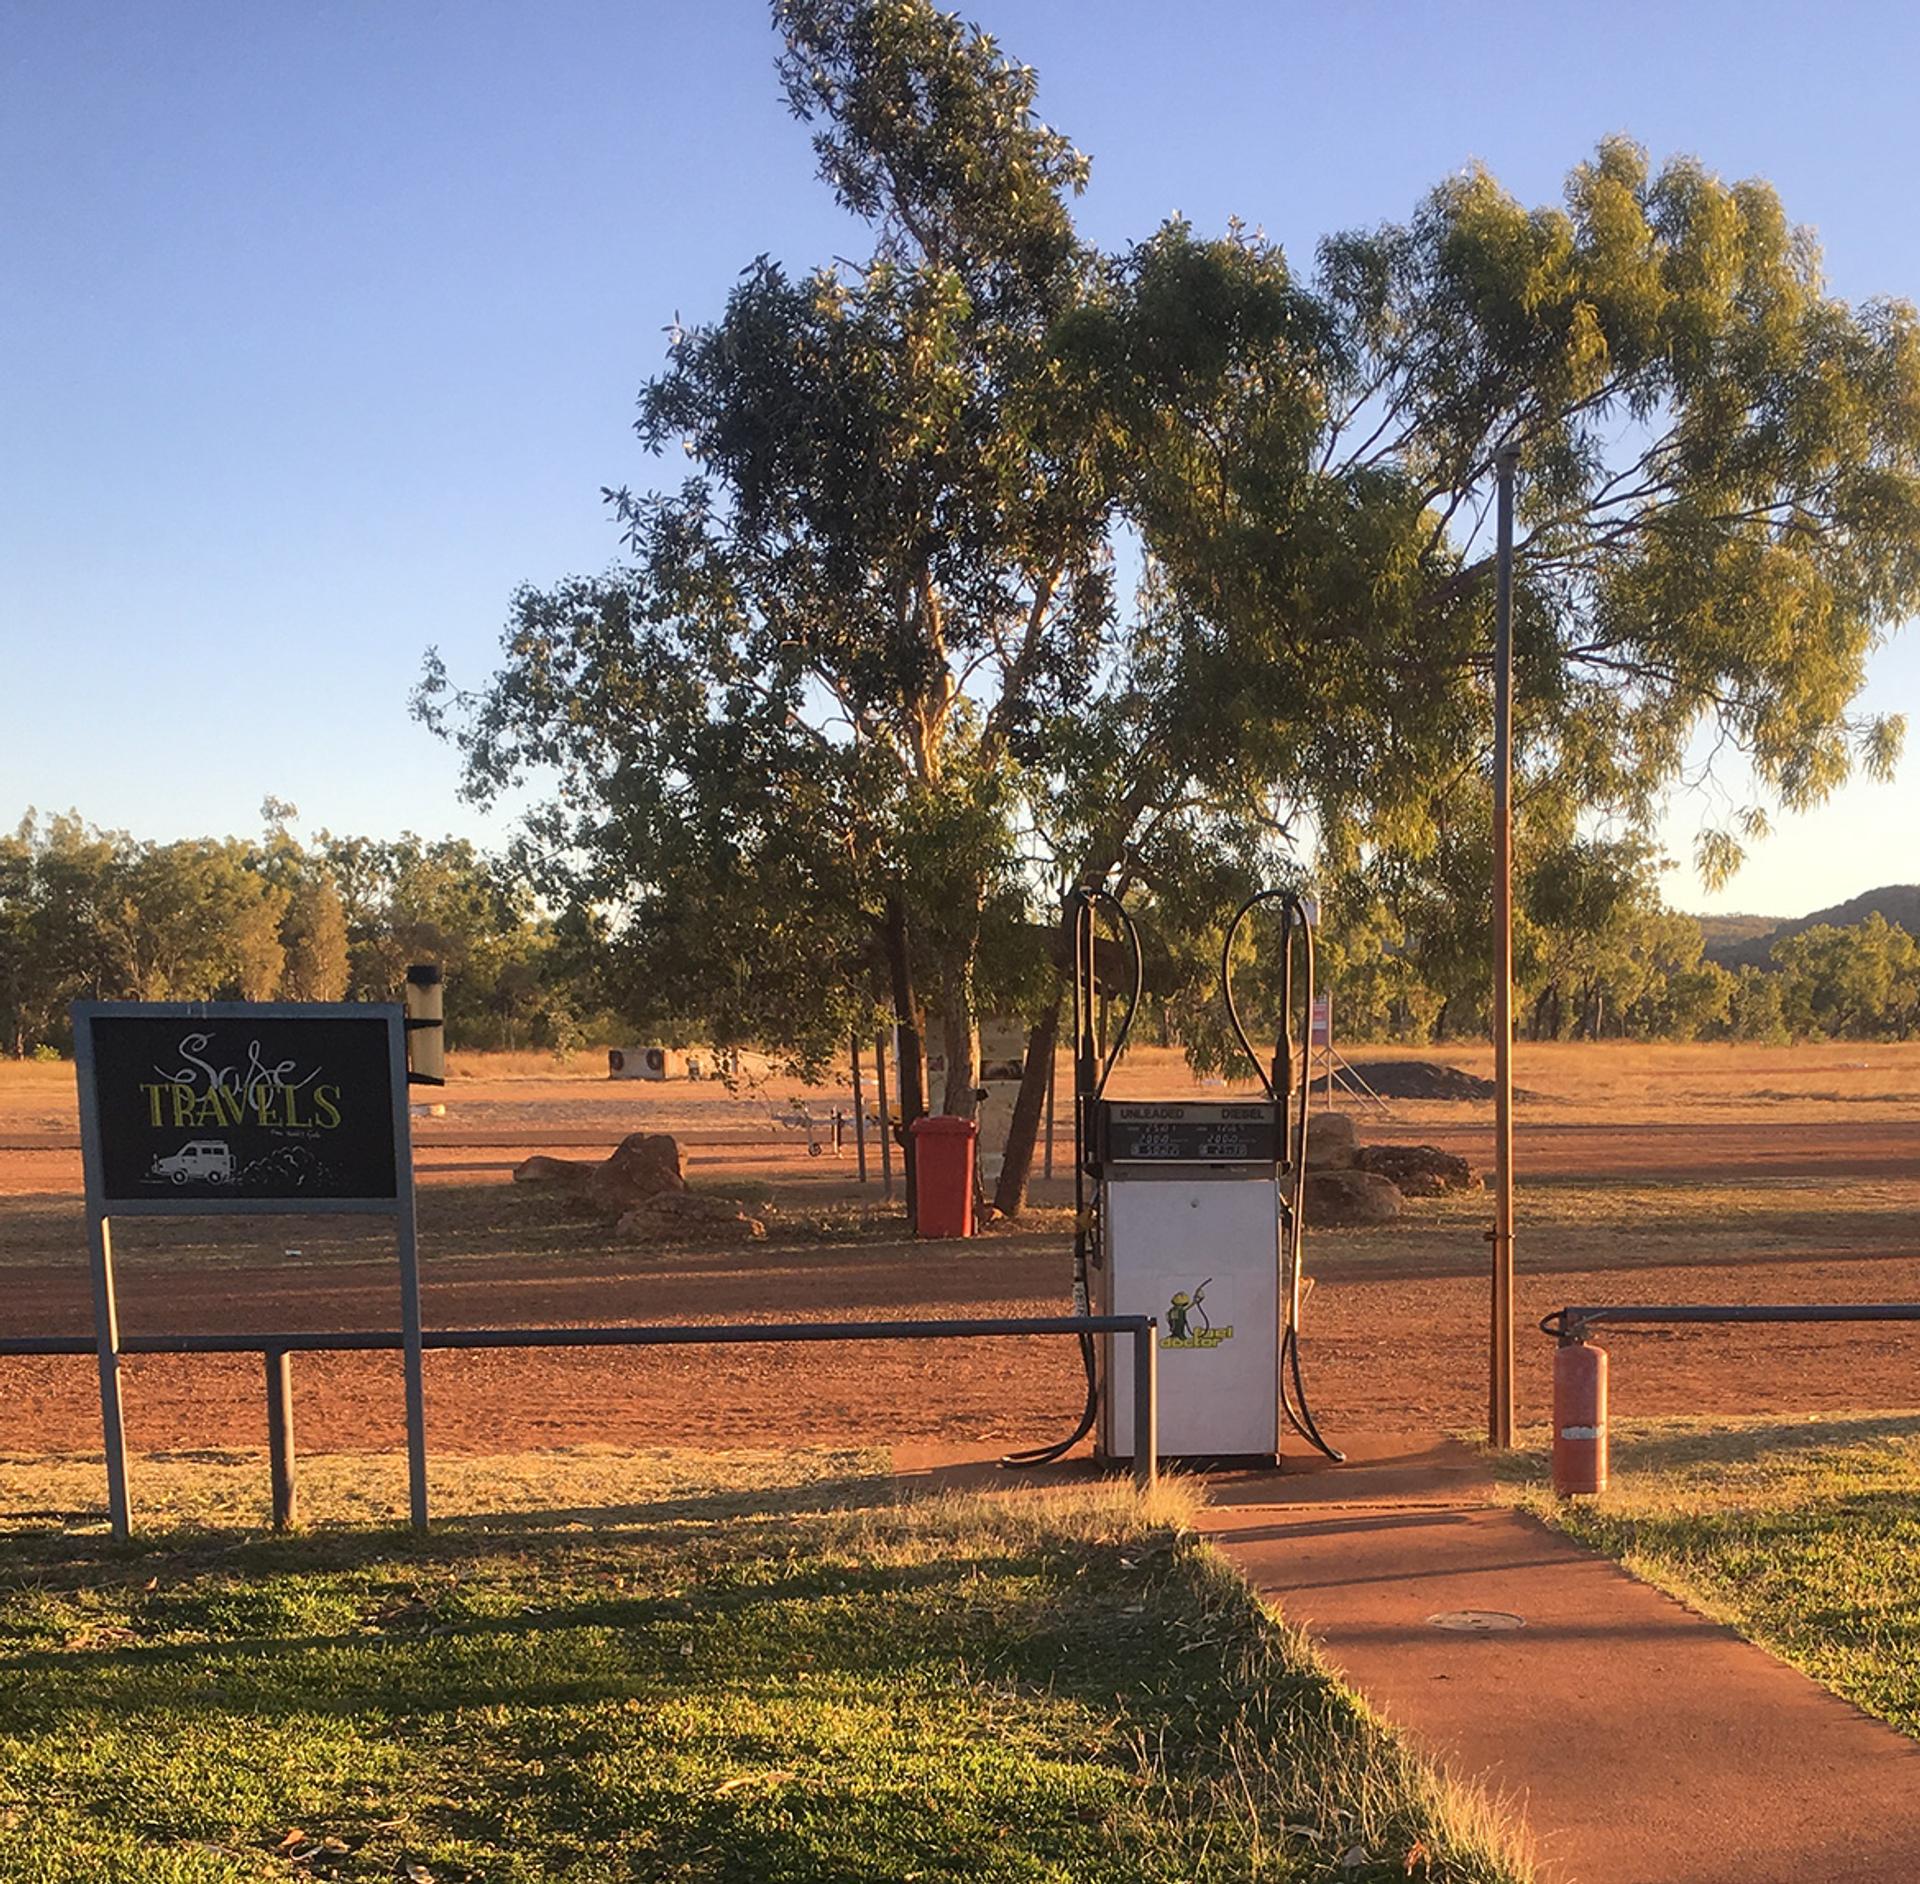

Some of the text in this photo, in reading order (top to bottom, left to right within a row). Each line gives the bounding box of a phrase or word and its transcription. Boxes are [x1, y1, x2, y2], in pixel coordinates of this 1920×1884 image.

[154, 1033, 322, 1110] Safe
[140, 1083, 341, 1129] TRAVELS
[1120, 1108, 1265, 1120] UNLEADED DIESEL
[1160, 1337, 1219, 1349] doctor
